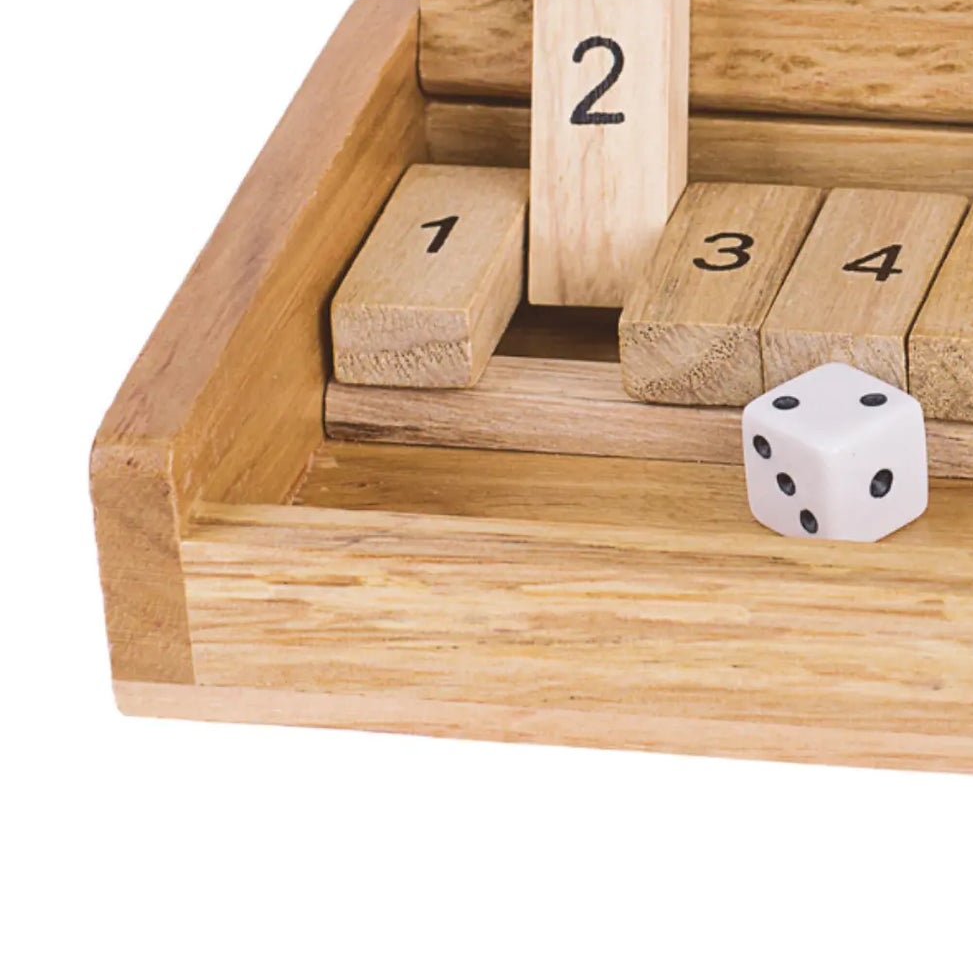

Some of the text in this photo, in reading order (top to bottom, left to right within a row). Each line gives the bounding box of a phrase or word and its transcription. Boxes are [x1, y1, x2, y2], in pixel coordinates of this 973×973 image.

[569, 35, 625, 125] 2
[420, 215, 459, 254] 1
[692, 231, 754, 272] 3
[842, 243, 904, 283] 4
